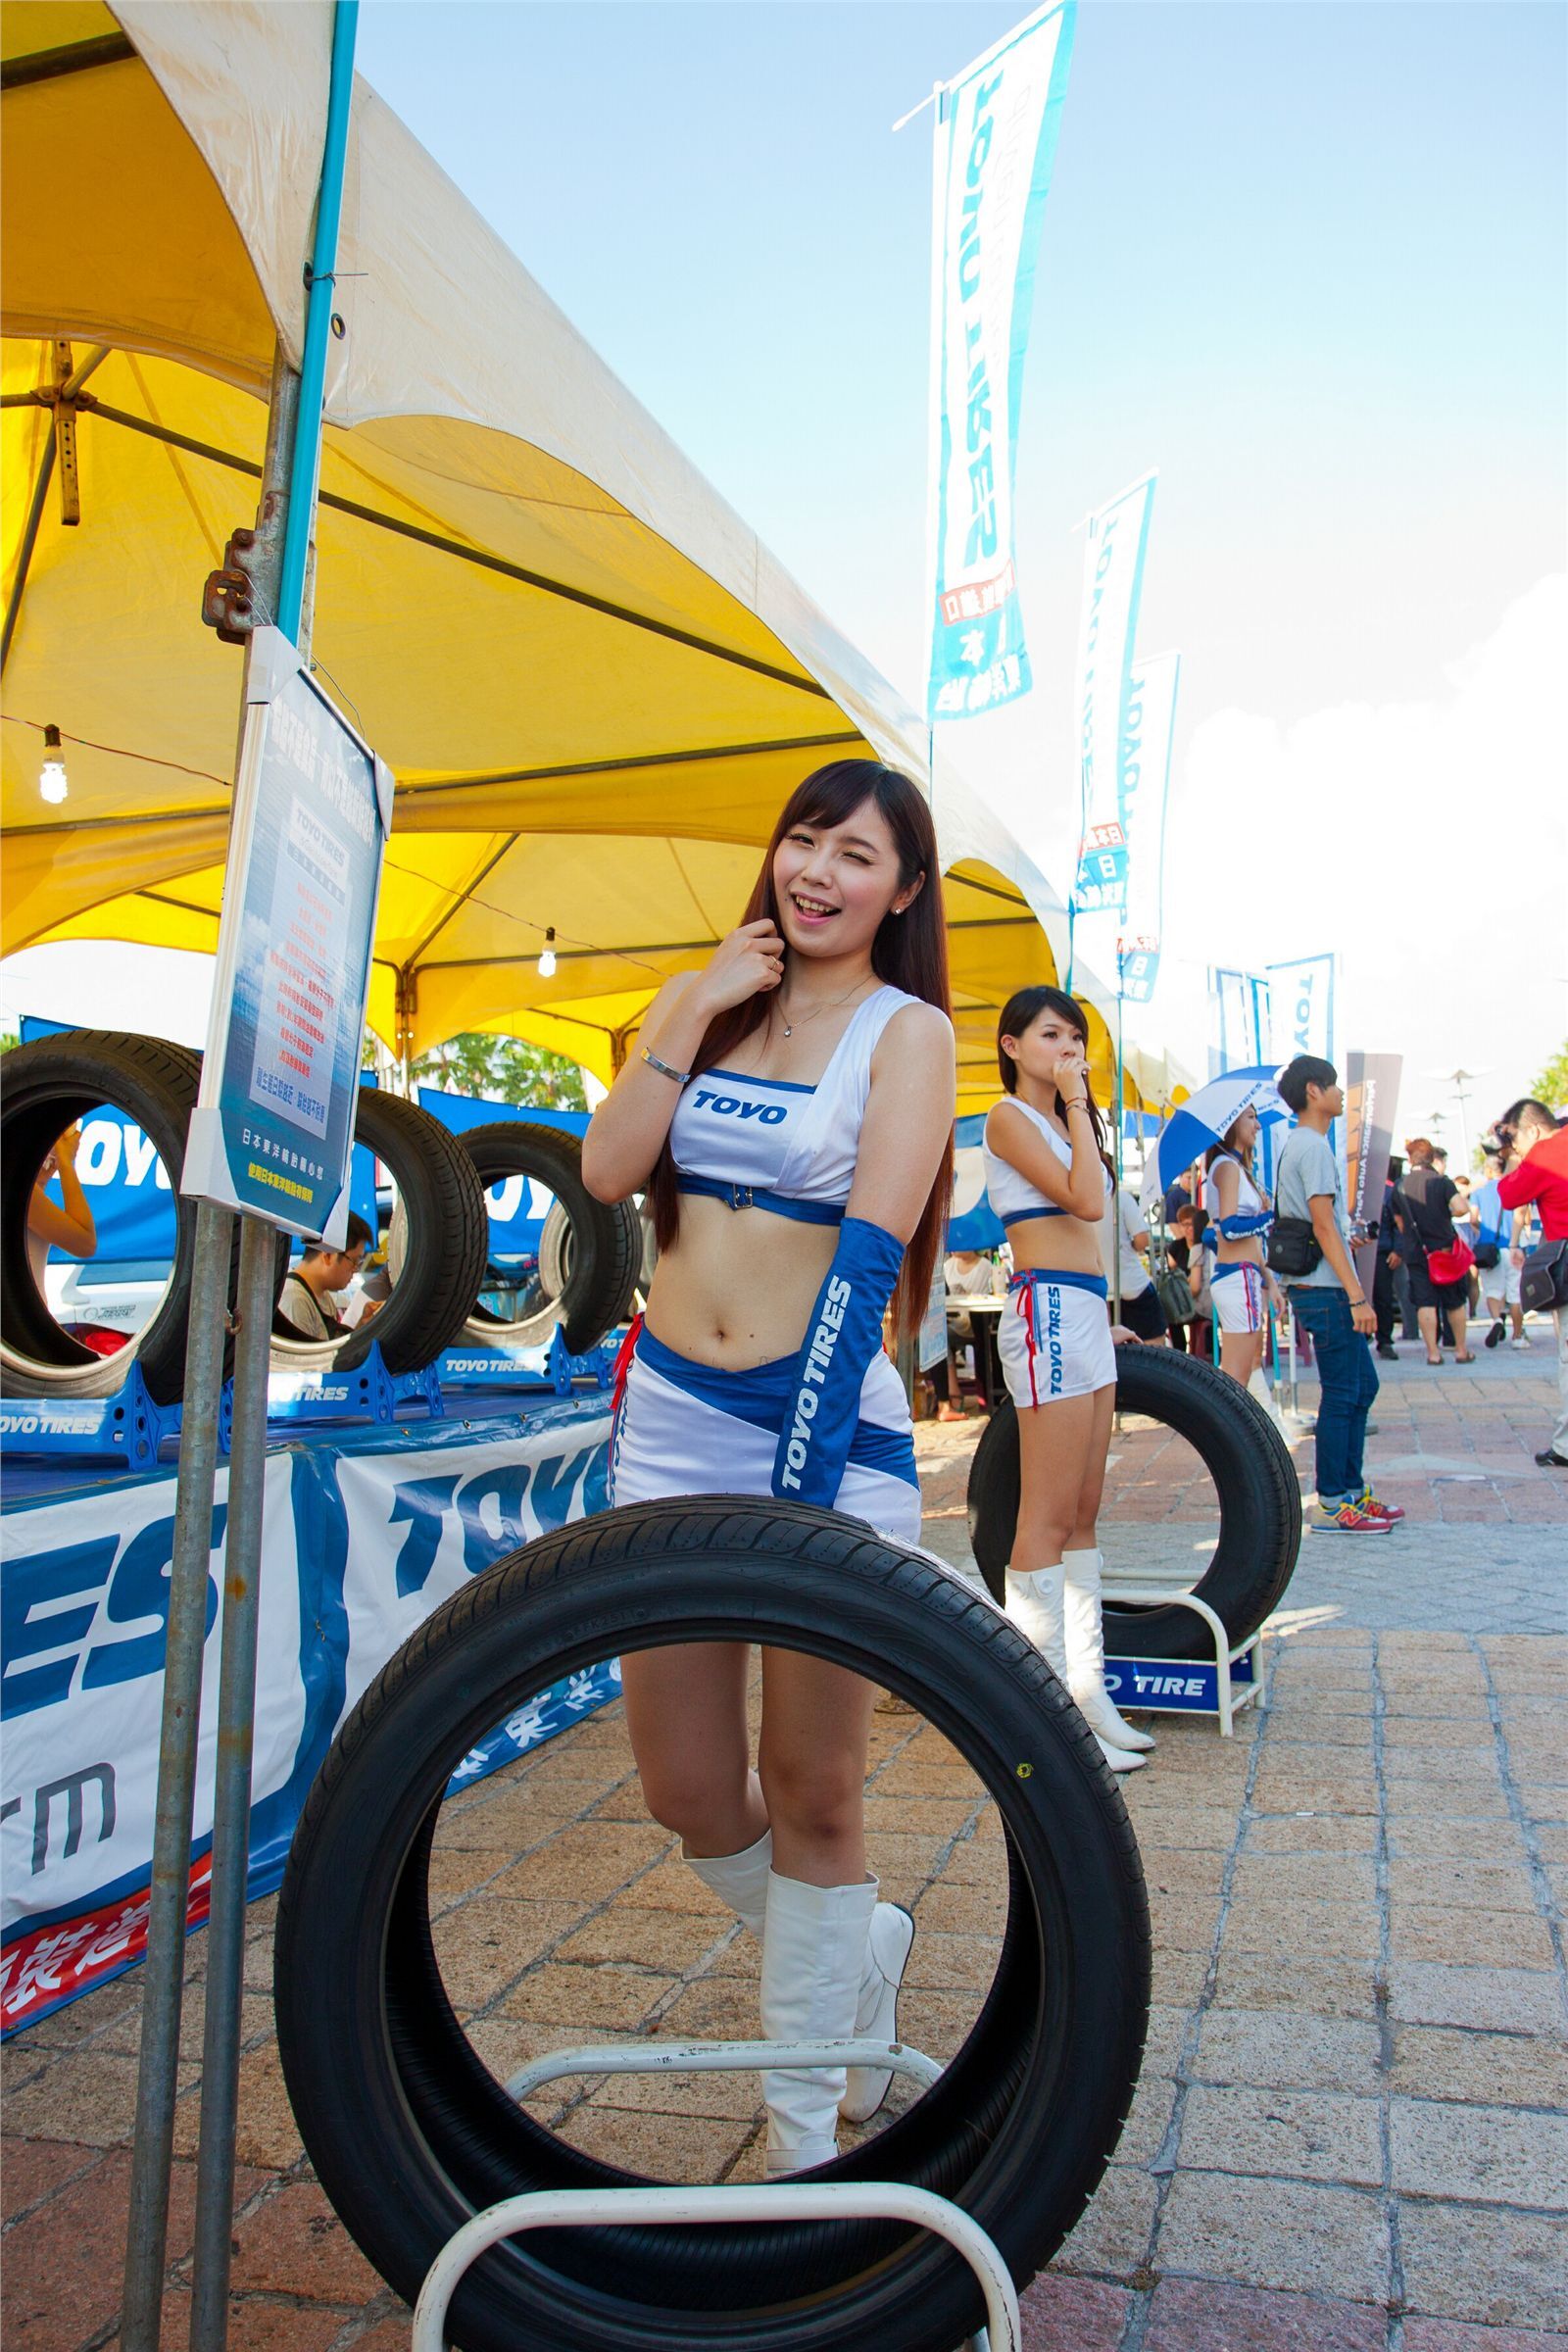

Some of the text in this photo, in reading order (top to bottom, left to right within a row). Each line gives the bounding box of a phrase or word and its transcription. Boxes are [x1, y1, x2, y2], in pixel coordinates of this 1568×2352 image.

[1294, 974, 1313, 1059] TOY
[692, 1090, 787, 1125] TOYO
[1216, 1082, 1262, 1133] TOYO TIRES
[1050, 1286, 1062, 1395] TOYO TIRES
[446, 1359, 489, 1371] TOYO
[782, 1274, 852, 1492] TOYO TIRES
[295, 1387, 349, 1401] TIRES
[39, 1416, 101, 1435] TIRES
[1134, 1675, 1206, 1696] TIRE
[453, 1656, 622, 1779] 東洋
